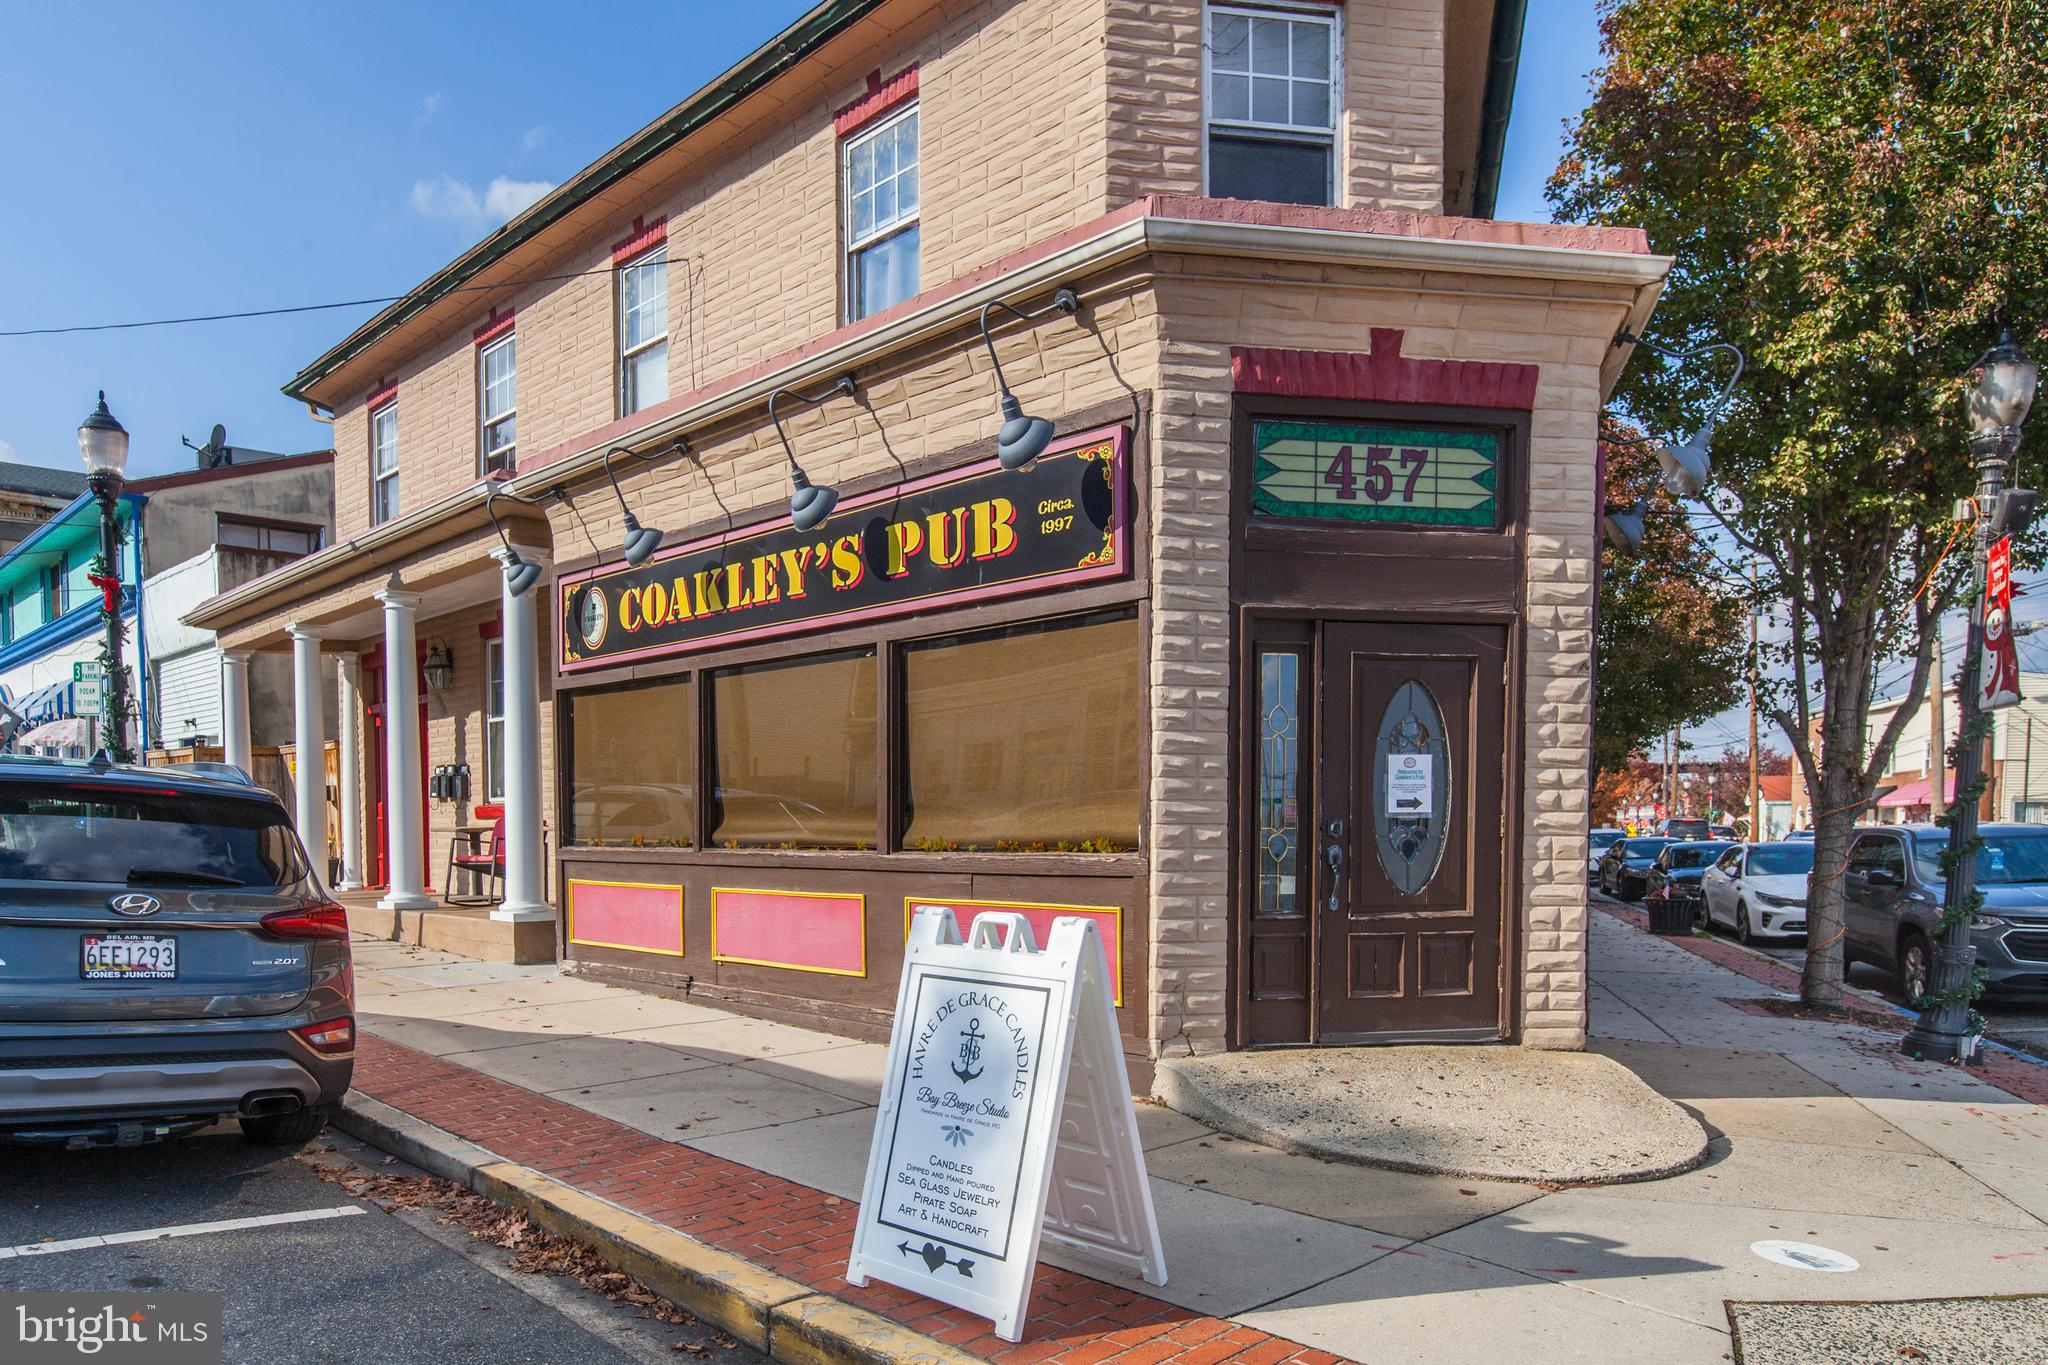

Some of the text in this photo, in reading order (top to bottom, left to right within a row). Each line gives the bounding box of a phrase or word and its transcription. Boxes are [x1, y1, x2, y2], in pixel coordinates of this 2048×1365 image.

[1324, 446, 1428, 502] 457
[1041, 515, 1073, 534] 1997
[619, 497, 1018, 633] COAKLEY'S PUB
[75, 665, 80, 679] 3
[87, 946, 173, 967] 6EE1293
[86, 971, 175, 979] JONES JUNCTION
[912, 991, 1029, 1101] HAVRE DE GRACE CANDLES
[916, 1086, 1010, 1119] Bay Breeze Studio
[920, 1209, 928, 1221] &
